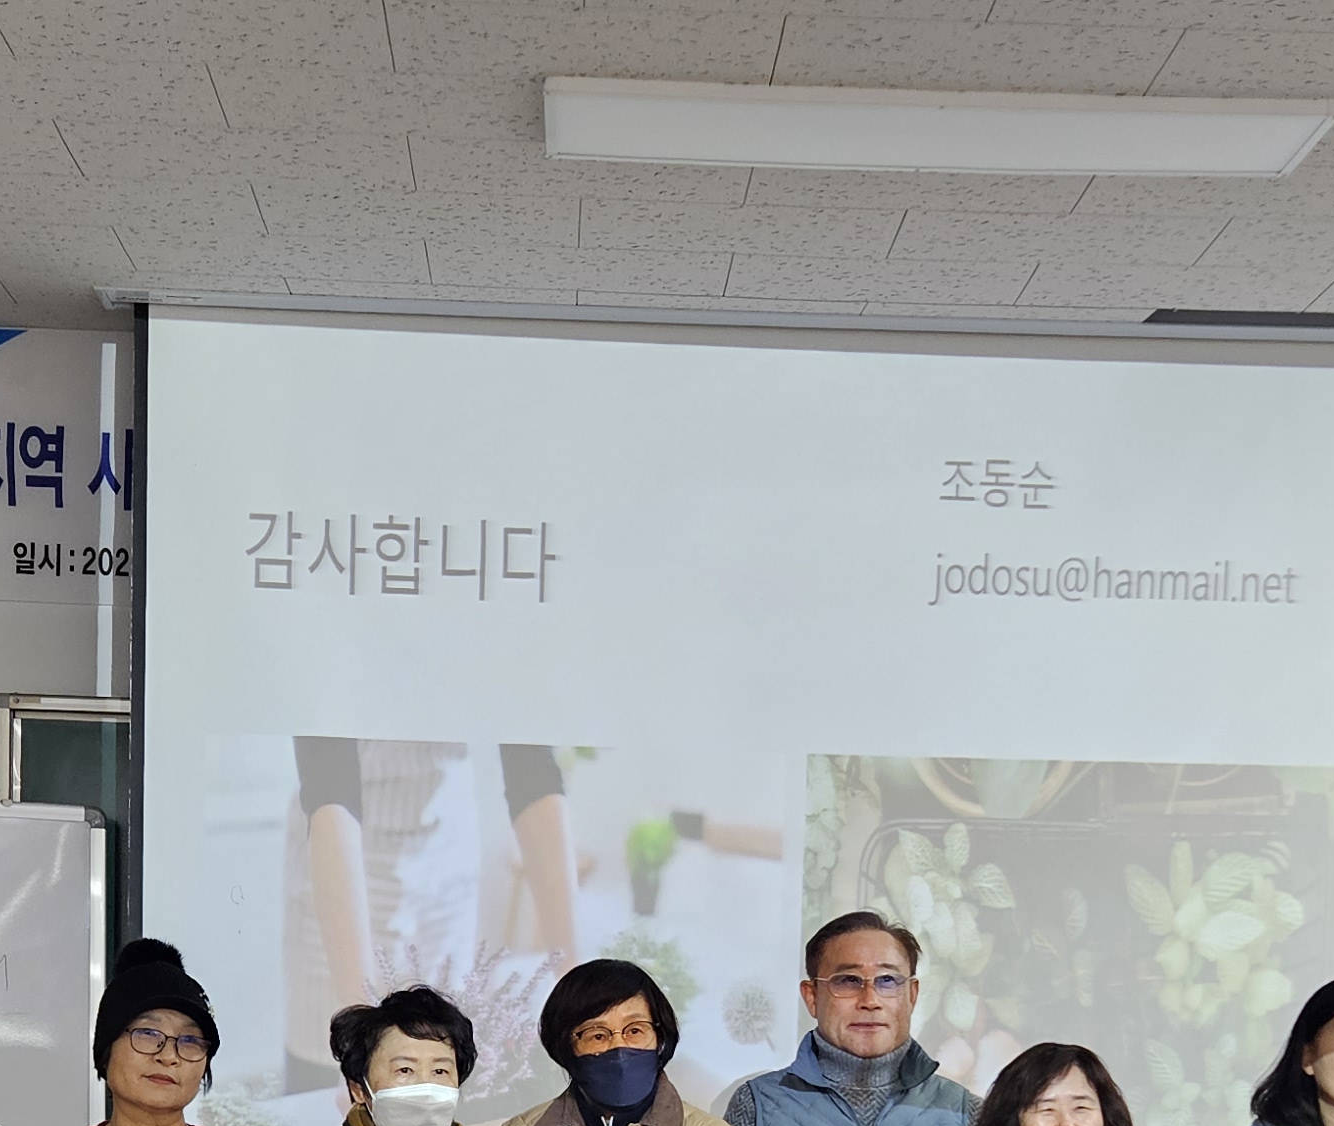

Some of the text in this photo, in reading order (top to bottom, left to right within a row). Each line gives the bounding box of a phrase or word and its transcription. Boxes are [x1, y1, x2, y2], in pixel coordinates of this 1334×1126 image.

[939, 459, 1055, 509] 조동순
[245, 511, 557, 603] 감사합니다
[928, 552, 1298, 606] jodosu@hanmail.net
